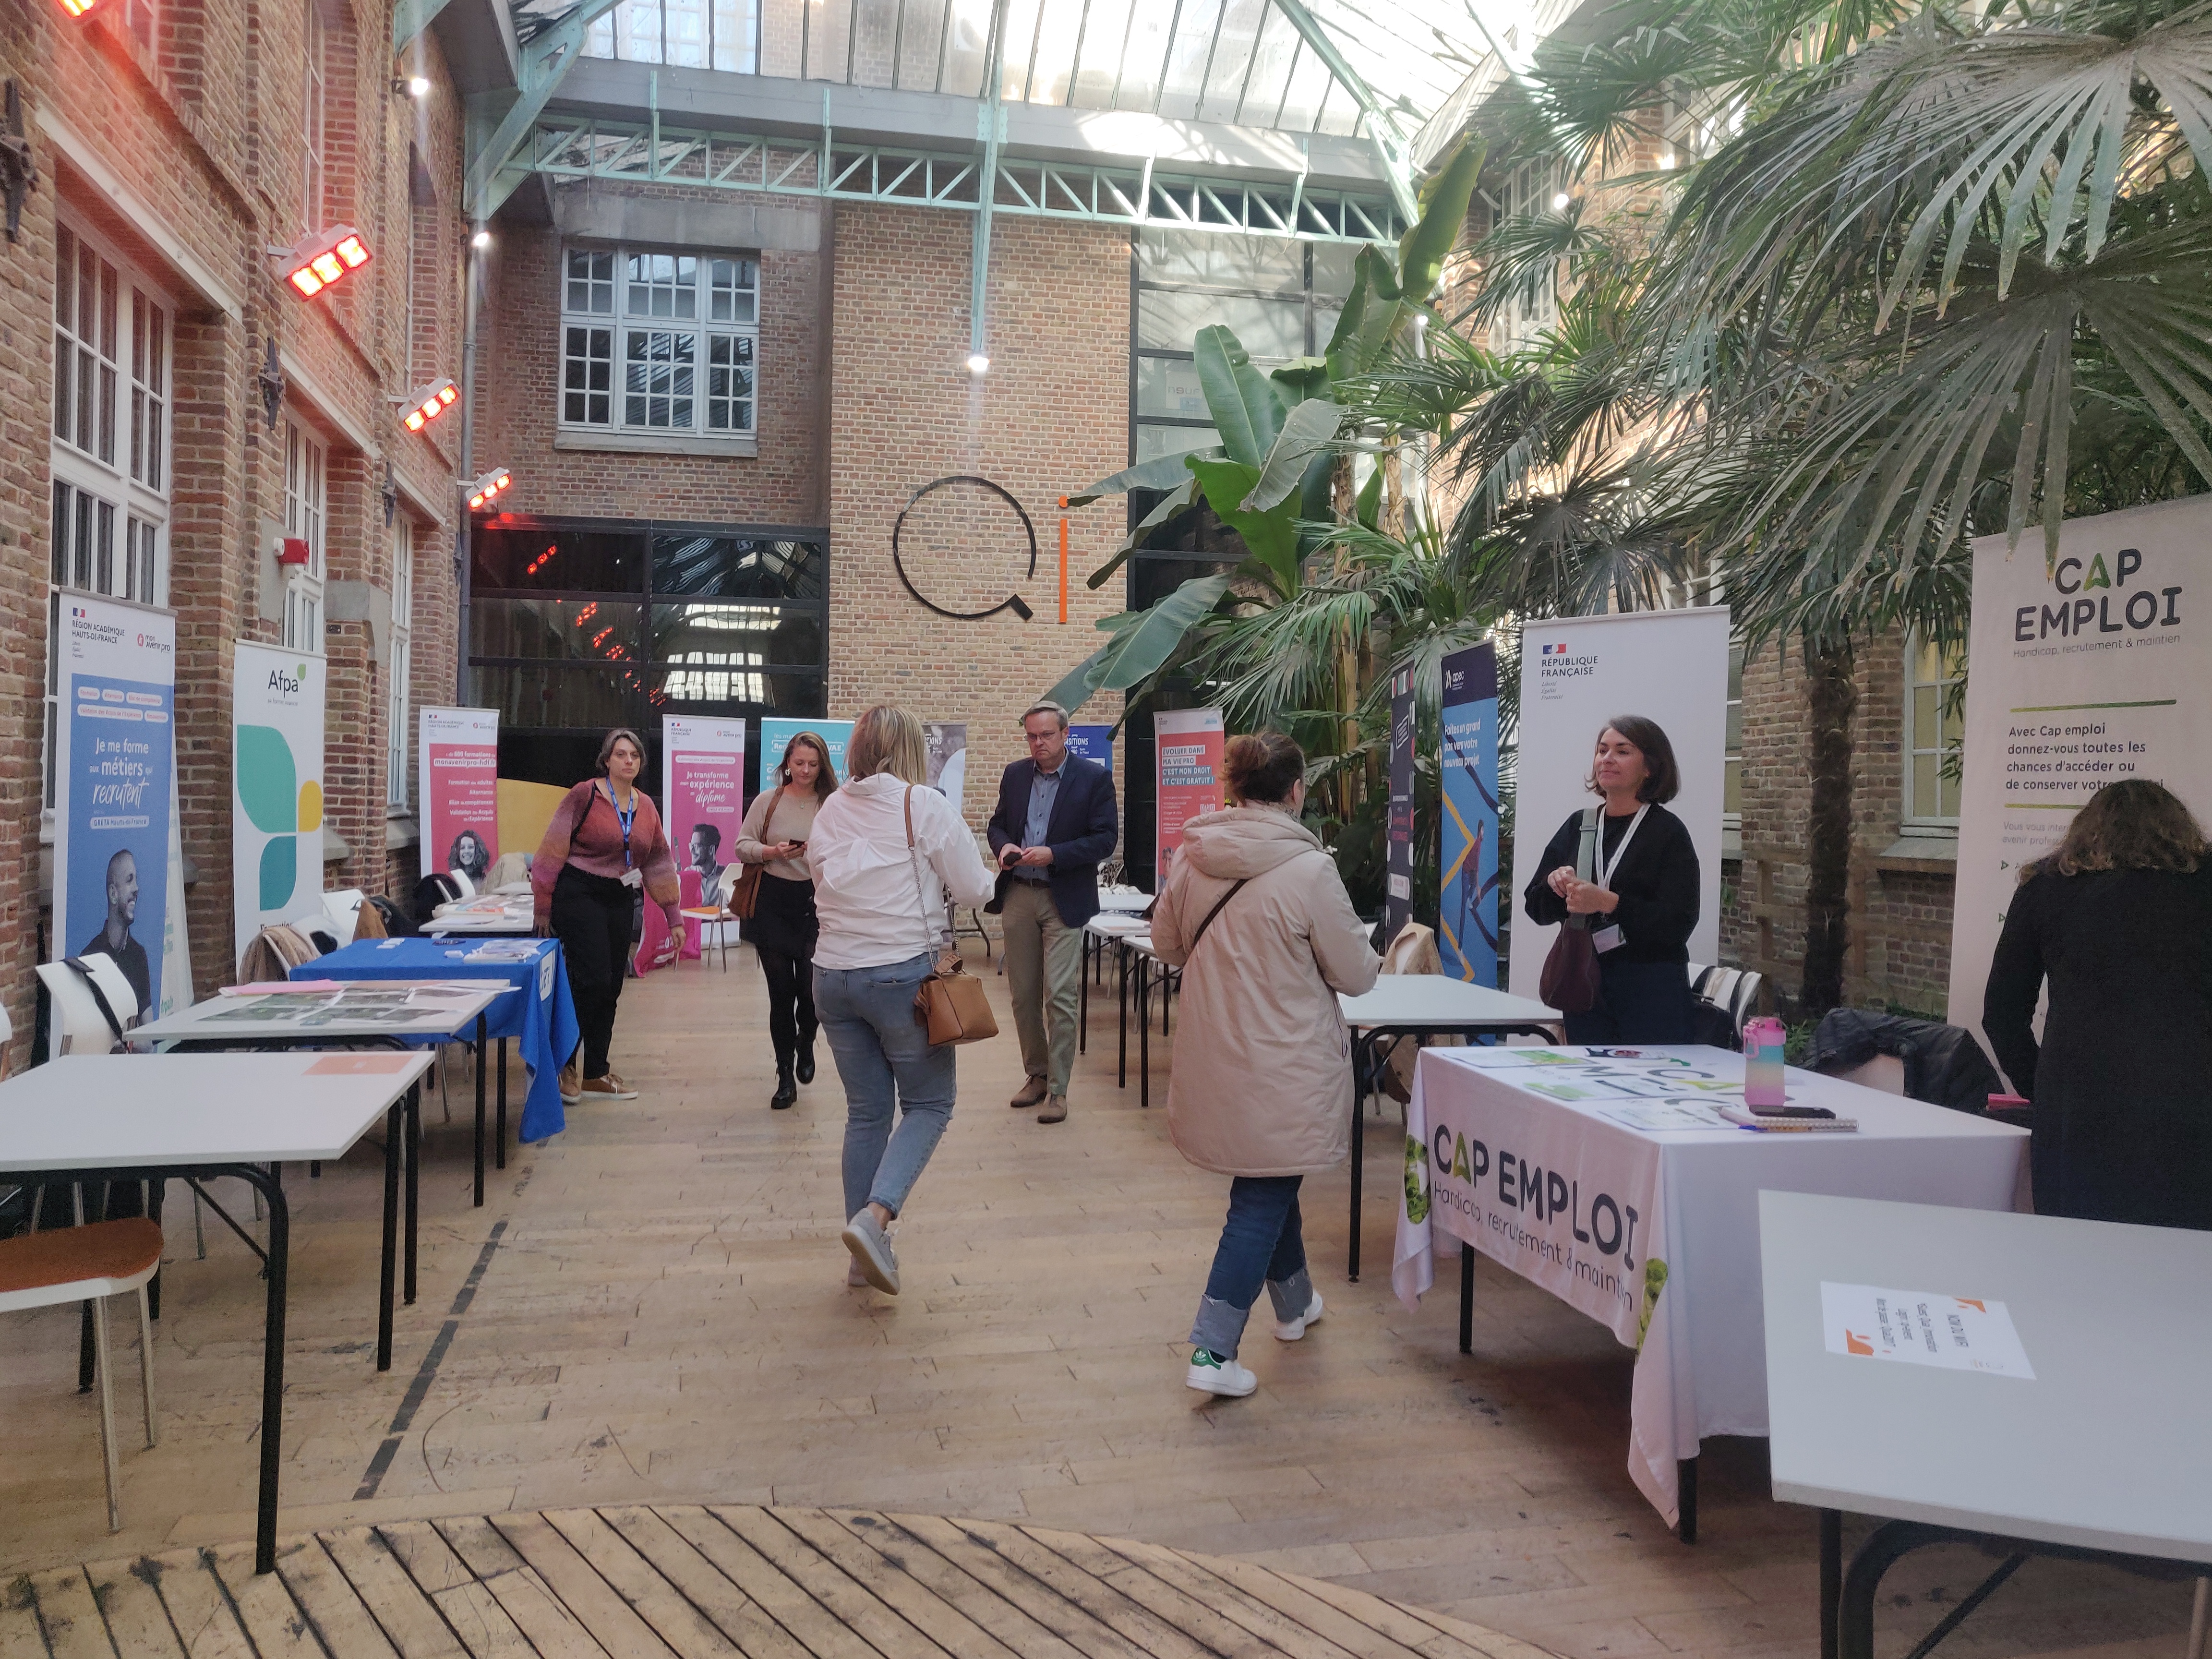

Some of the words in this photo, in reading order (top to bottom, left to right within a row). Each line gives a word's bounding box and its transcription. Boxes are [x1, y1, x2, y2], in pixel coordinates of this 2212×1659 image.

[2055, 548, 2142, 594] CAP
[2015, 586, 2183, 642] EMPLOI
[72, 619, 92, 630] RÉGION
[93, 624, 125, 637] ACADÉMIQUE
[161, 644, 170, 653] pro
[2063, 640, 2122, 654] recrutement
[2126, 638, 2133, 647] &
[2137, 635, 2180, 647] maintien
[1542, 656, 1598, 667] RÉPUBLIQUE
[1453, 671, 1464, 684] apec
[1541, 667, 1594, 677] FRANÇAISE
[268, 669, 298, 698] Afpa
[1444, 723, 1459, 735] Faites
[1460, 724, 1465, 733] un
[1466, 717, 1480, 735] grand
[2008, 727, 2036, 737] Avec
[2040, 726, 2061, 737] Cap
[2065, 722, 2105, 737] emploi
[95, 737, 105, 755] Je
[108, 742, 120, 753] me
[123, 738, 149, 754] forme
[1464, 738, 1478, 749] votre
[2008, 744, 2079, 754] donnez-vous
[2083, 742, 2124, 753] toutes
[2128, 741, 2146, 753] les
[101, 756, 143, 776] métiers
[2007, 761, 2052, 772] chances
[2056, 758, 2114, 772] d'accéder
[2118, 761, 2135, 771] ou
[694, 771, 729, 779] transforme
[689, 779, 734, 791] expérience
[2006, 779, 2019, 790] de
[2023, 781, 2078, 790] conserver
[93, 777, 149, 810] recrutent
[695, 789, 726, 808] diplôme
[2004, 821, 2023, 830] Vous
[1433, 1124, 1489, 1188] CAP
[1499, 1150, 1638, 1272] EMPLOI
[1488, 1211, 1563, 1265] recrutement
